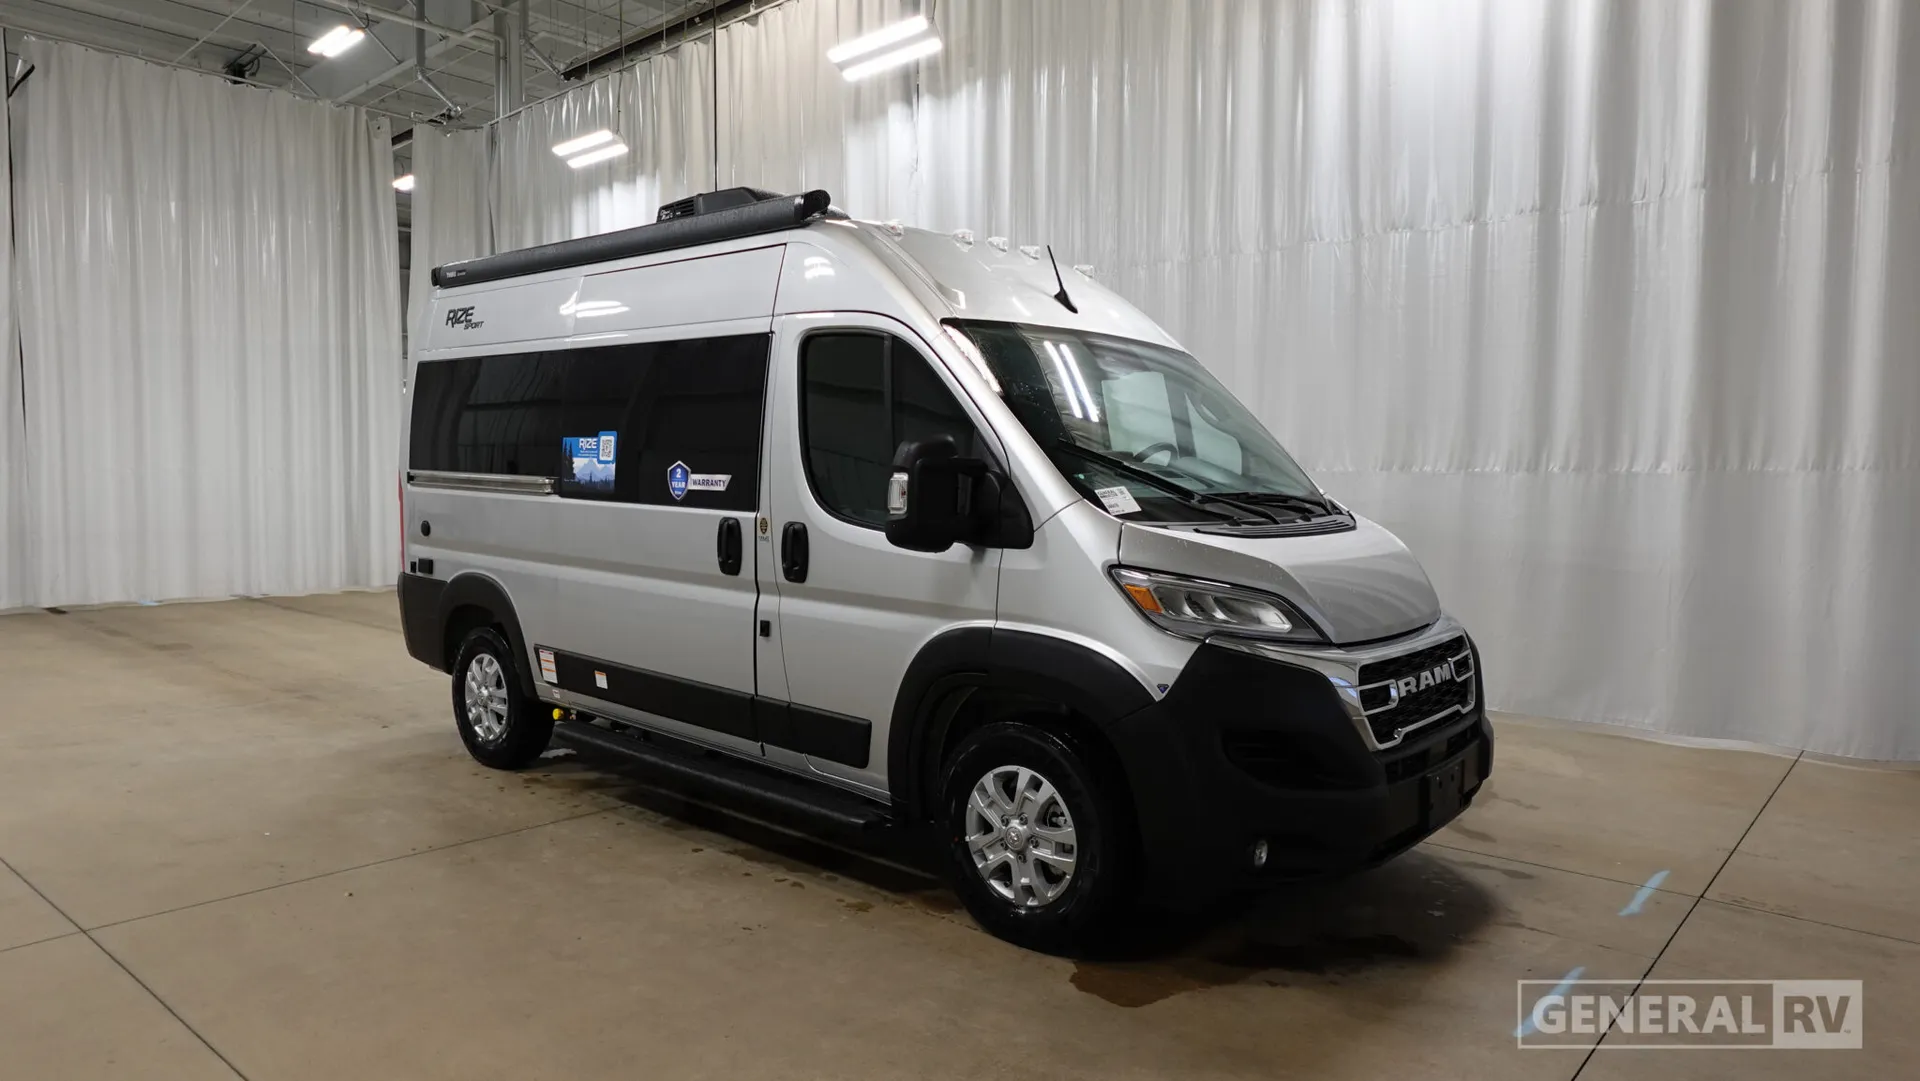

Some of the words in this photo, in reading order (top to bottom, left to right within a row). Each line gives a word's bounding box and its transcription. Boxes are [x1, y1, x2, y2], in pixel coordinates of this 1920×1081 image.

[445, 306, 475, 328] RIZE
[463, 320, 485, 330] SPORT
[579, 438, 598, 450] RIZE
[676, 468, 682, 478] 2
[671, 481, 686, 489] YEAR
[692, 478, 727, 488] WARRANTY
[1397, 663, 1452, 698] RAM
